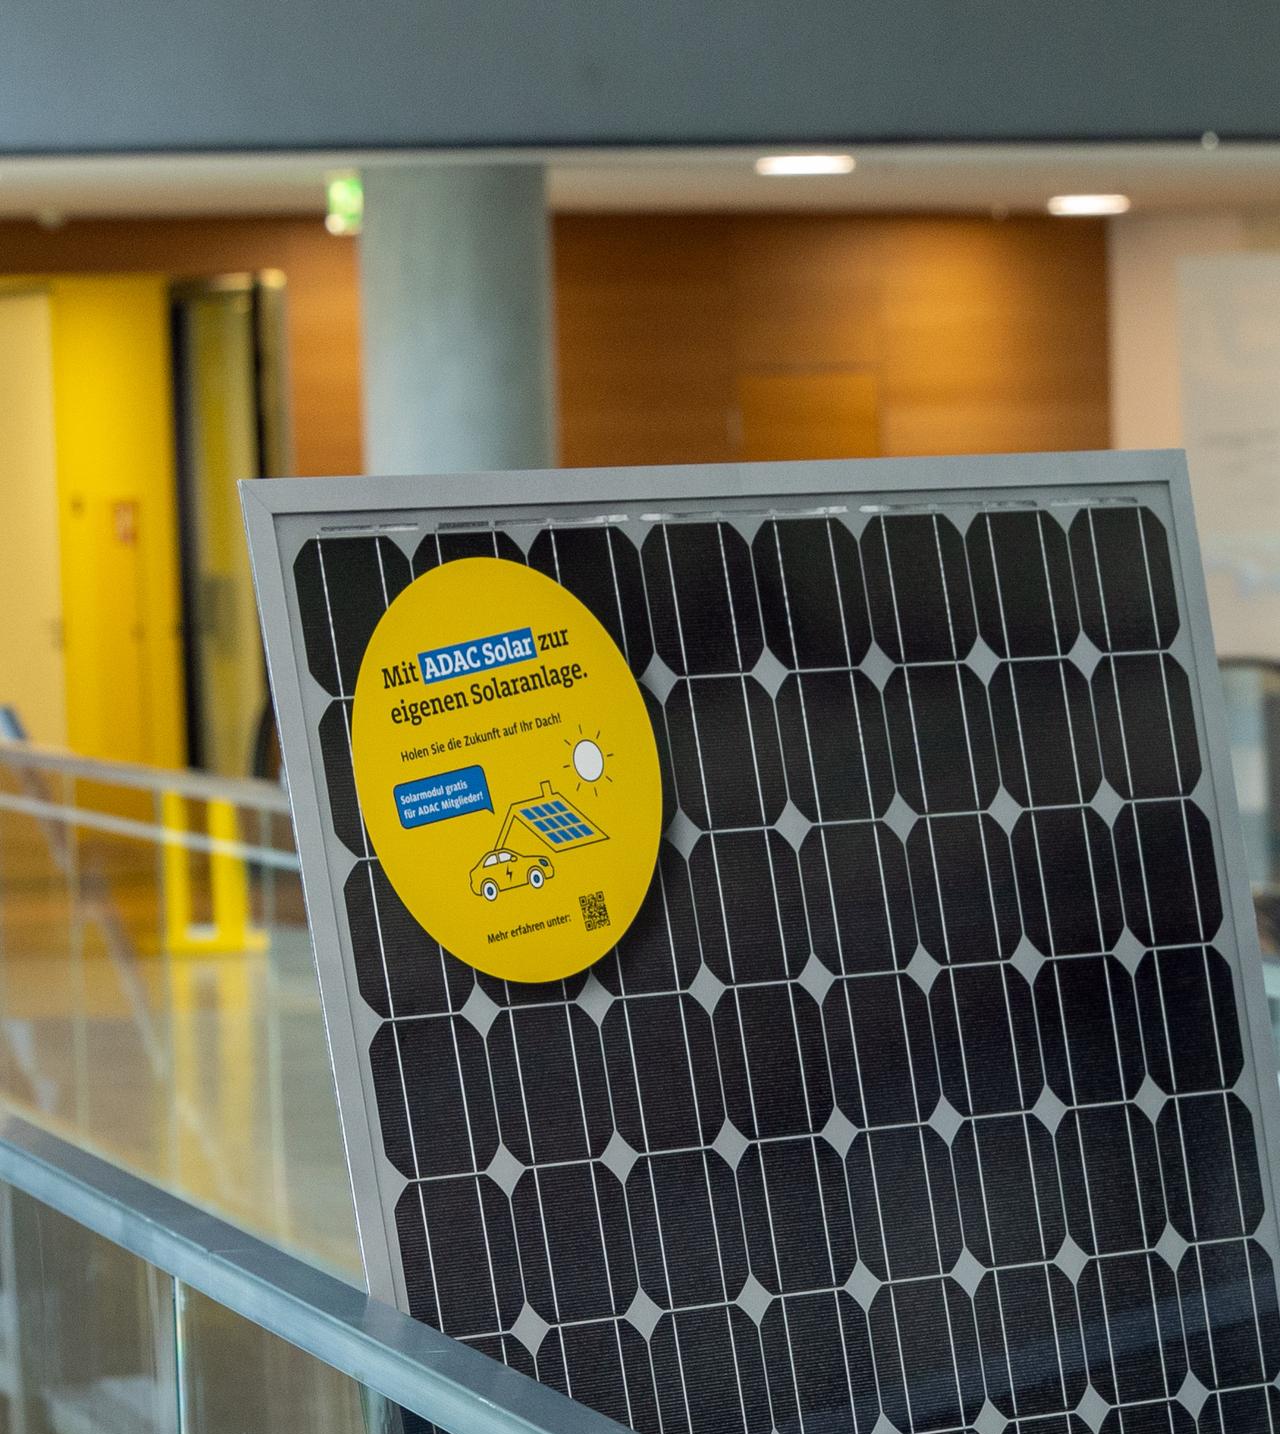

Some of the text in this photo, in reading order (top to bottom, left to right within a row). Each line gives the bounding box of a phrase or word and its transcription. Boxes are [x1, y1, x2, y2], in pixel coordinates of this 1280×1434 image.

[381, 629, 569, 689] Mit ADAC Solar zur
[391, 662, 588, 726] eigenen Solaranlage.
[400, 712, 563, 762] Holen Sie die Zukunft auf Ihr Dach!
[400, 779, 469, 806] Solarmodul gratis
[403, 791, 484, 820] für ADAC Mitglieder!
[487, 914, 573, 944] Mehr erfahren unter:
